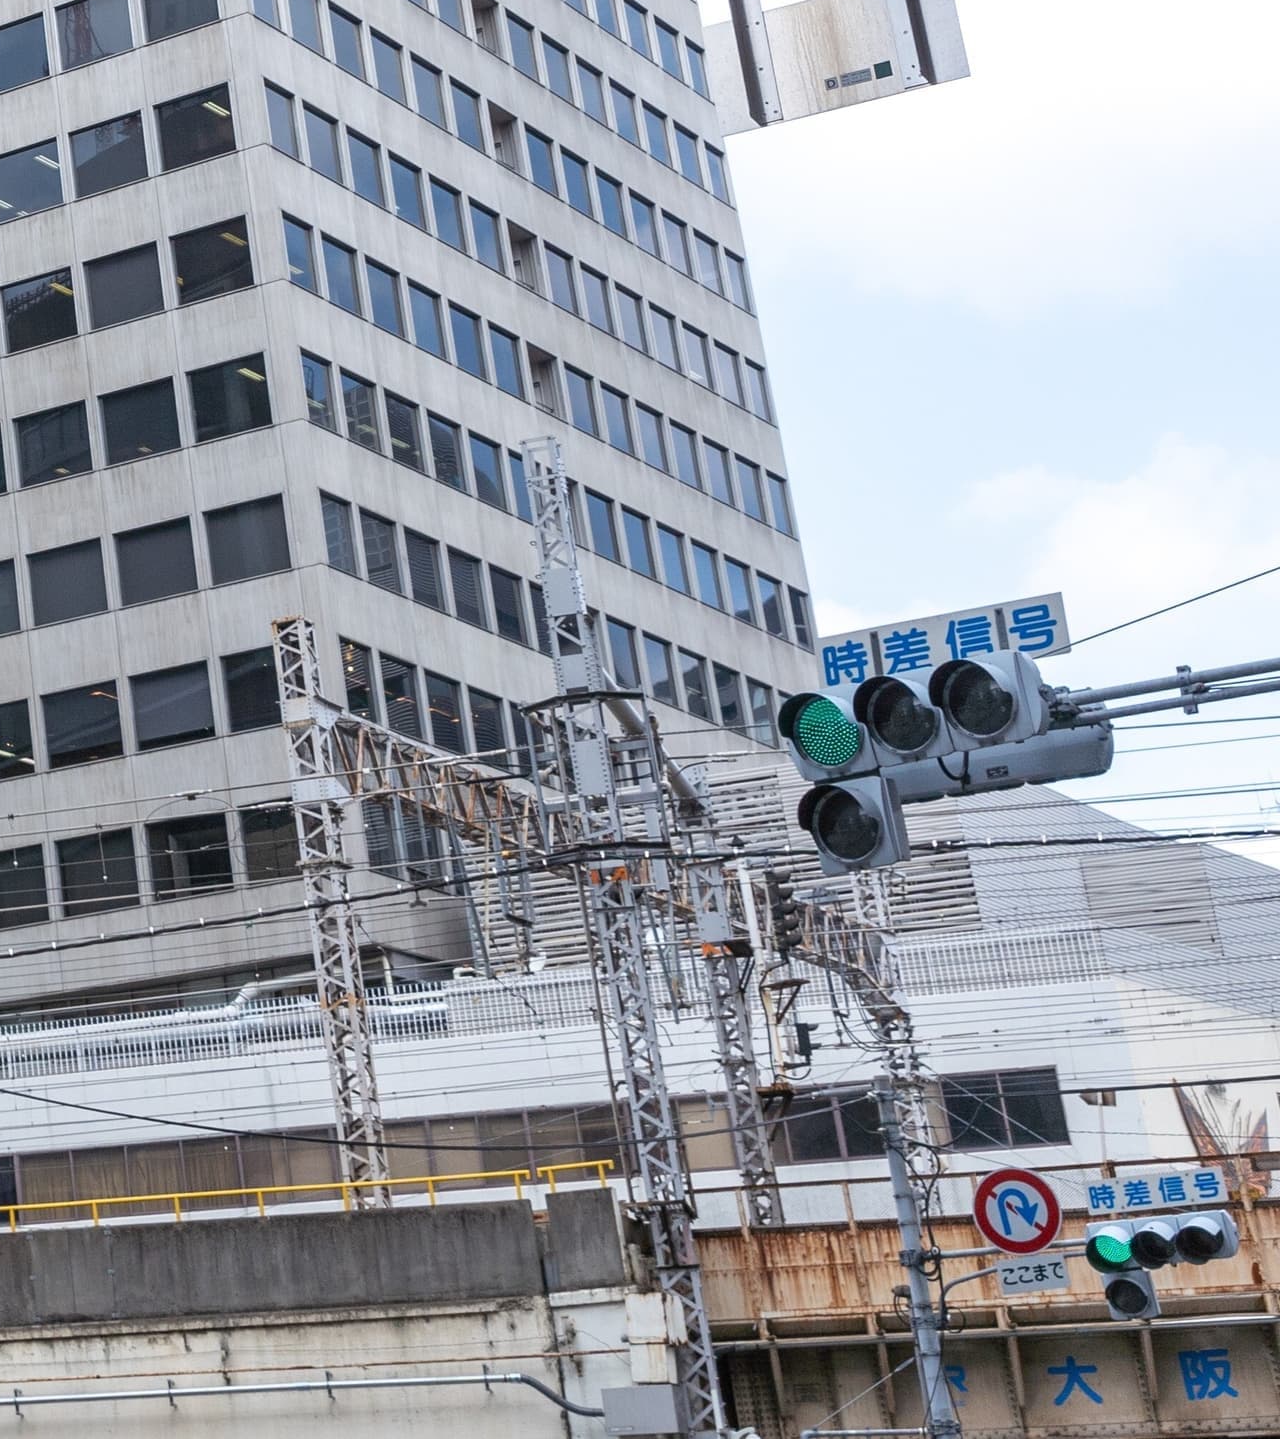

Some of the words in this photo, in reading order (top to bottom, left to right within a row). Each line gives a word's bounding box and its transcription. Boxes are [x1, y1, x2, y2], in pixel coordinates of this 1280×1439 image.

[822, 604, 1057, 687] 時差信号
[1088, 1172, 1220, 1209] 時差信号
[1002, 1262, 1064, 1285] ここまで
